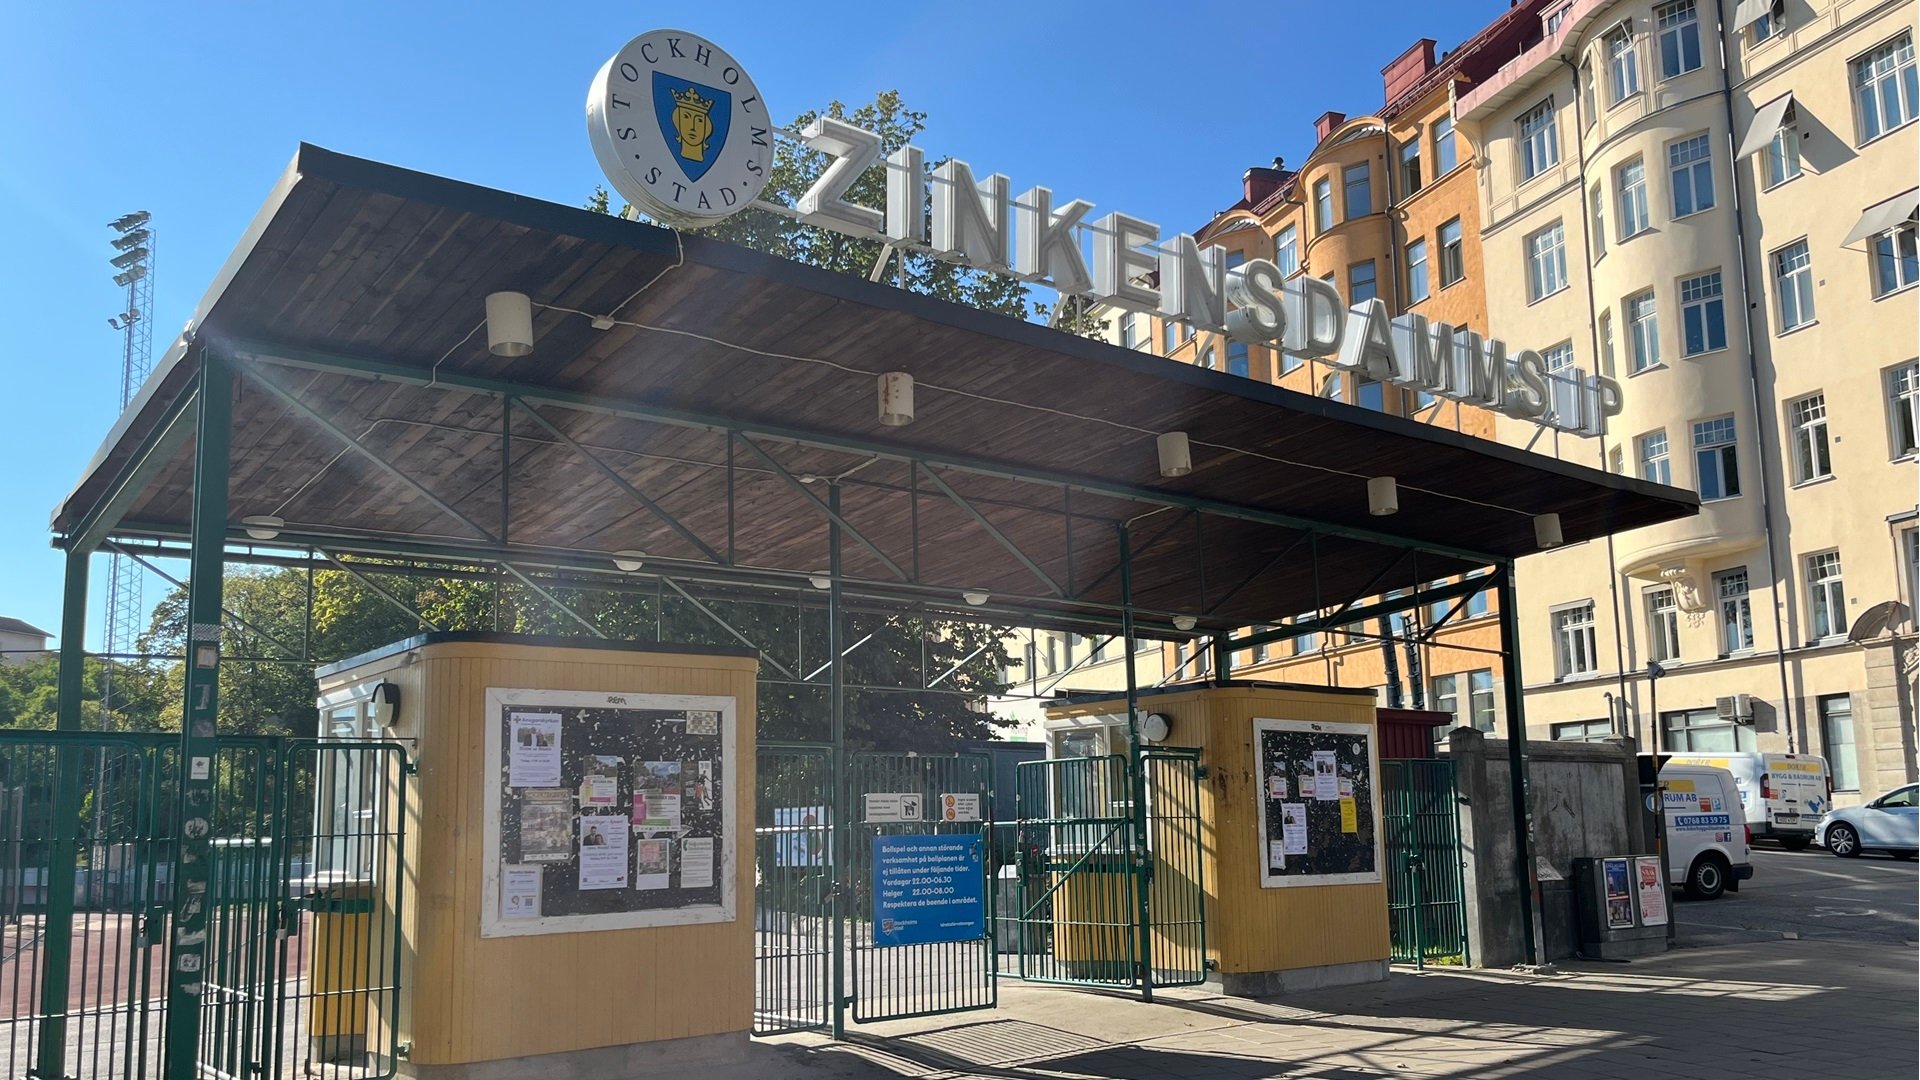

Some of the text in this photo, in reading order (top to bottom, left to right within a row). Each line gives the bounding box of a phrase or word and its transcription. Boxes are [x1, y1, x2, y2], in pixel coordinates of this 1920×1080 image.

[611, 38, 768, 177] STOCKHOLMS
[644, 166, 737, 210] STAD
[797, 115, 1624, 438] ZINKENSDAMMS IP
[1664, 793, 1698, 802] RUM AB
[1683, 816, 1700, 825] 0768
[1700, 816, 1709, 824] 83
[1719, 816, 1728, 824] 75
[882, 845, 906, 854] Bollspel
[938, 843, 963, 851] störande
[882, 856, 918, 864] verksamhet
[918, 856, 927, 864] på
[927, 855, 958, 863] bollplanen
[889, 867, 911, 875] tillåten
[930, 865, 954, 874] följande
[882, 876, 952, 887] Vardagar 22.00-06.30
[883, 887, 954, 898] Helger 22.00-08.00
[883, 901, 917, 909] Respektera
[951, 896, 978, 904] området.
